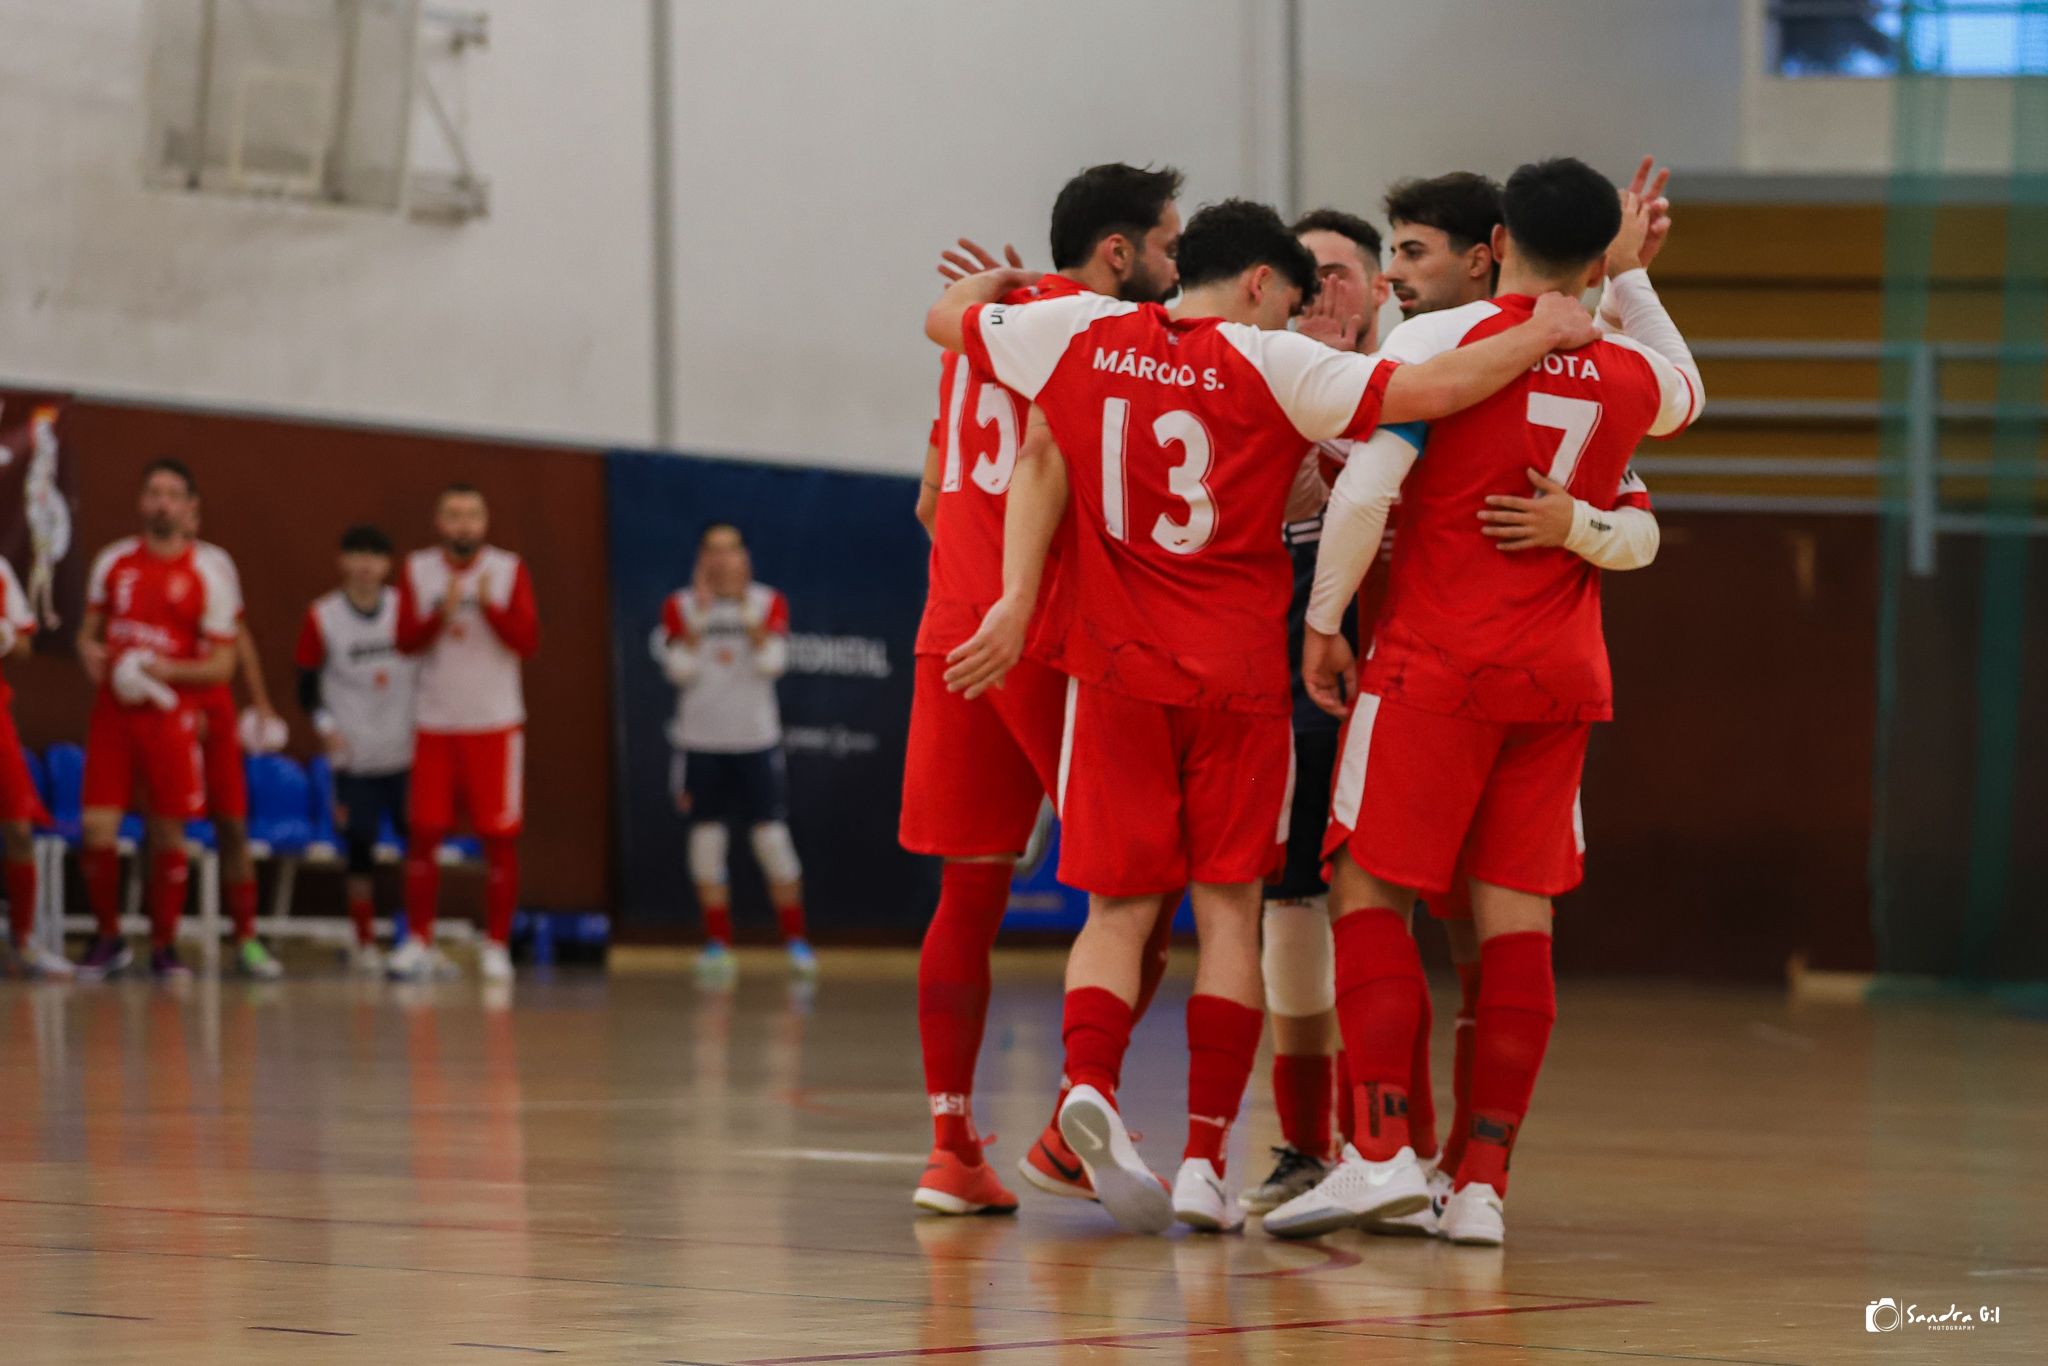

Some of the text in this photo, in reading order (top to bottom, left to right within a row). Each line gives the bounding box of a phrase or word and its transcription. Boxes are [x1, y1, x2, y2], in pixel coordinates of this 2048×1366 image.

[1092, 346, 1226, 392] MÁRCIO S.
[1101, 396, 1220, 556] 13
[1526, 391, 1603, 501] 7
